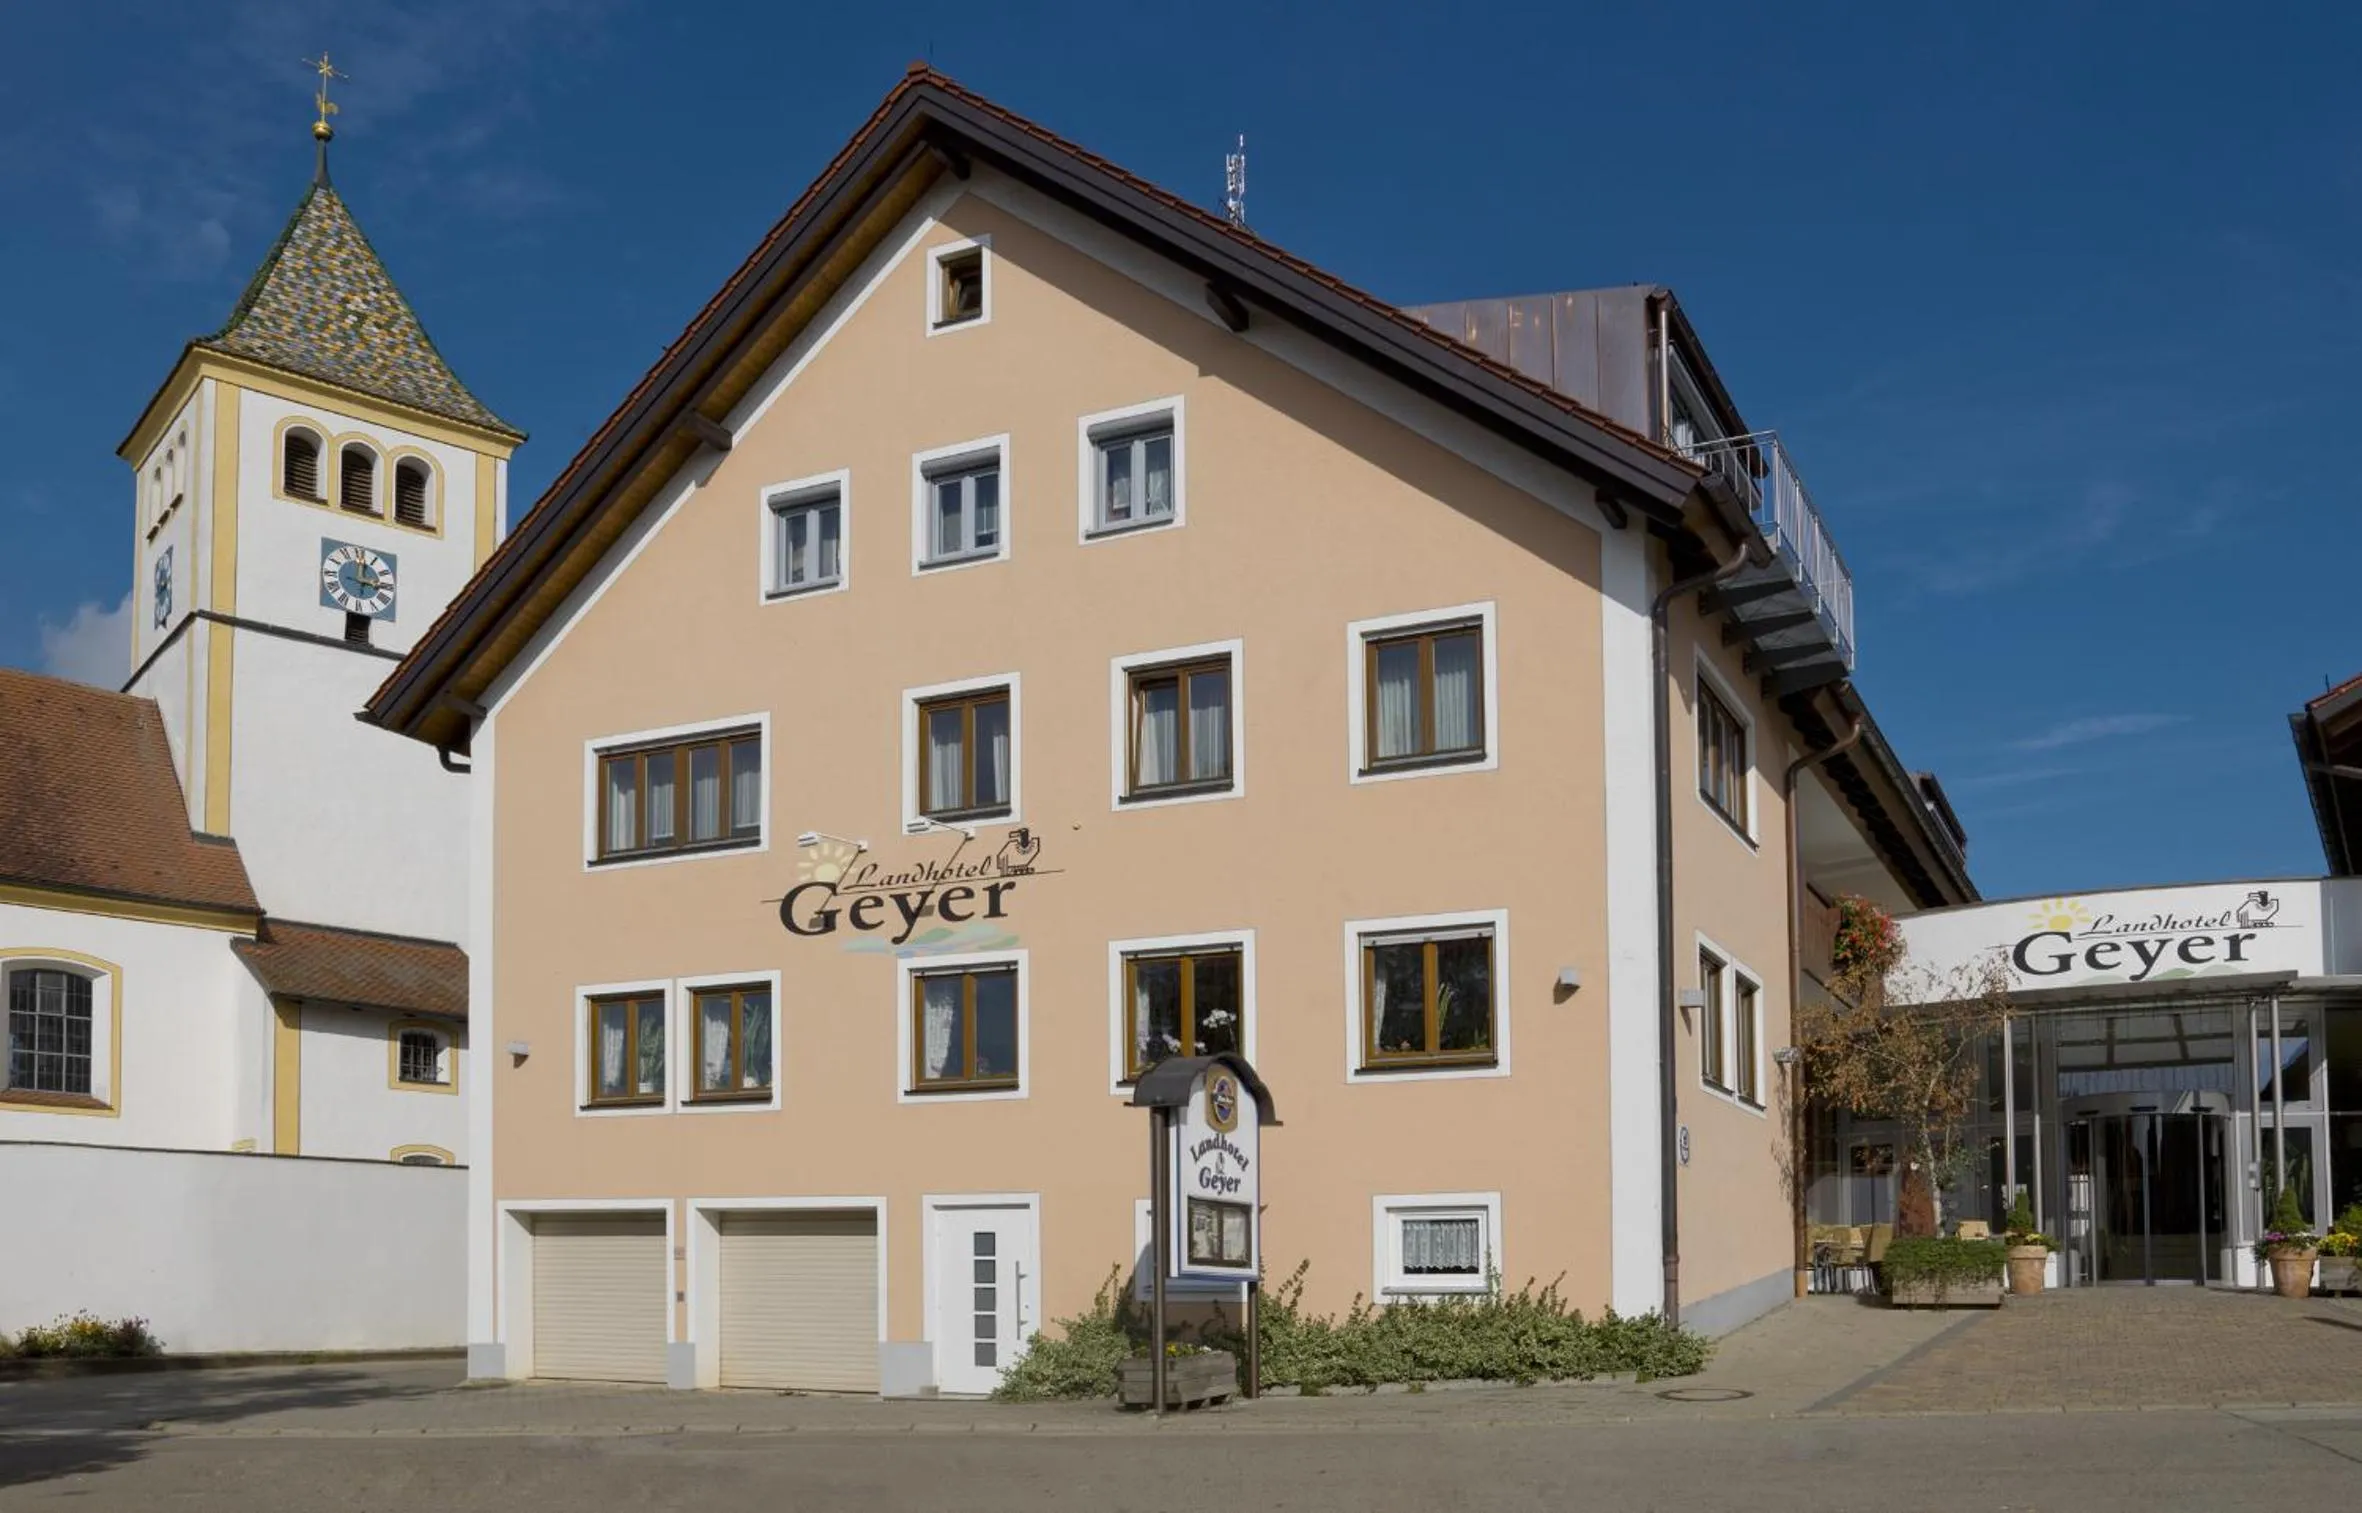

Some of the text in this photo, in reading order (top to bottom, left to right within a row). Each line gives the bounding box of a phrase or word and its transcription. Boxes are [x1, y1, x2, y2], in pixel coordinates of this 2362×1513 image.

[844, 856, 992, 890] Landhotel
[780, 881, 1016, 945] Geyer
[2080, 911, 2231, 935] Landhotel
[2012, 931, 2257, 982] Geyer
[1190, 1133, 1249, 1172] Landhotel
[1199, 1166, 1241, 1195] Geyer
